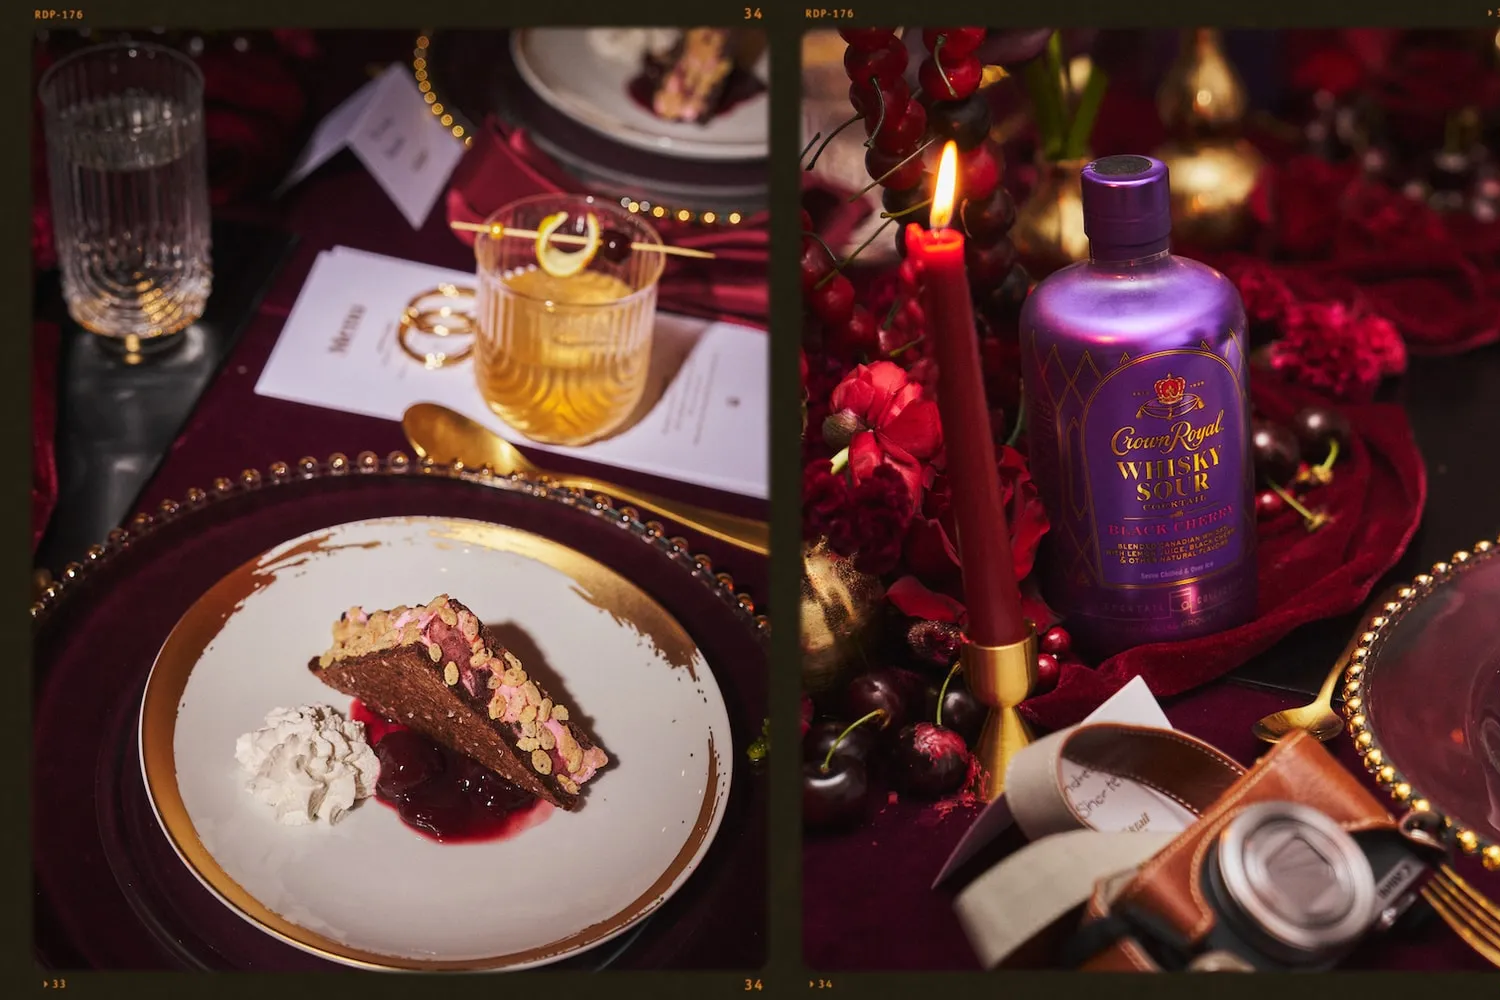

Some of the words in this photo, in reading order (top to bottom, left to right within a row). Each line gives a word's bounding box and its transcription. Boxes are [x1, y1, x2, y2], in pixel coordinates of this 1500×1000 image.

[1111, 426, 1171, 456] Crown
[1160, 409, 1223, 454] Royal
[1116, 447, 1219, 480] WHISKY
[1136, 472, 1210, 502] SOUR
[1143, 495, 1206, 511] COCKTAIL
[1108, 523, 1168, 537] BLACK
[1174, 505, 1234, 532] CHERRY
